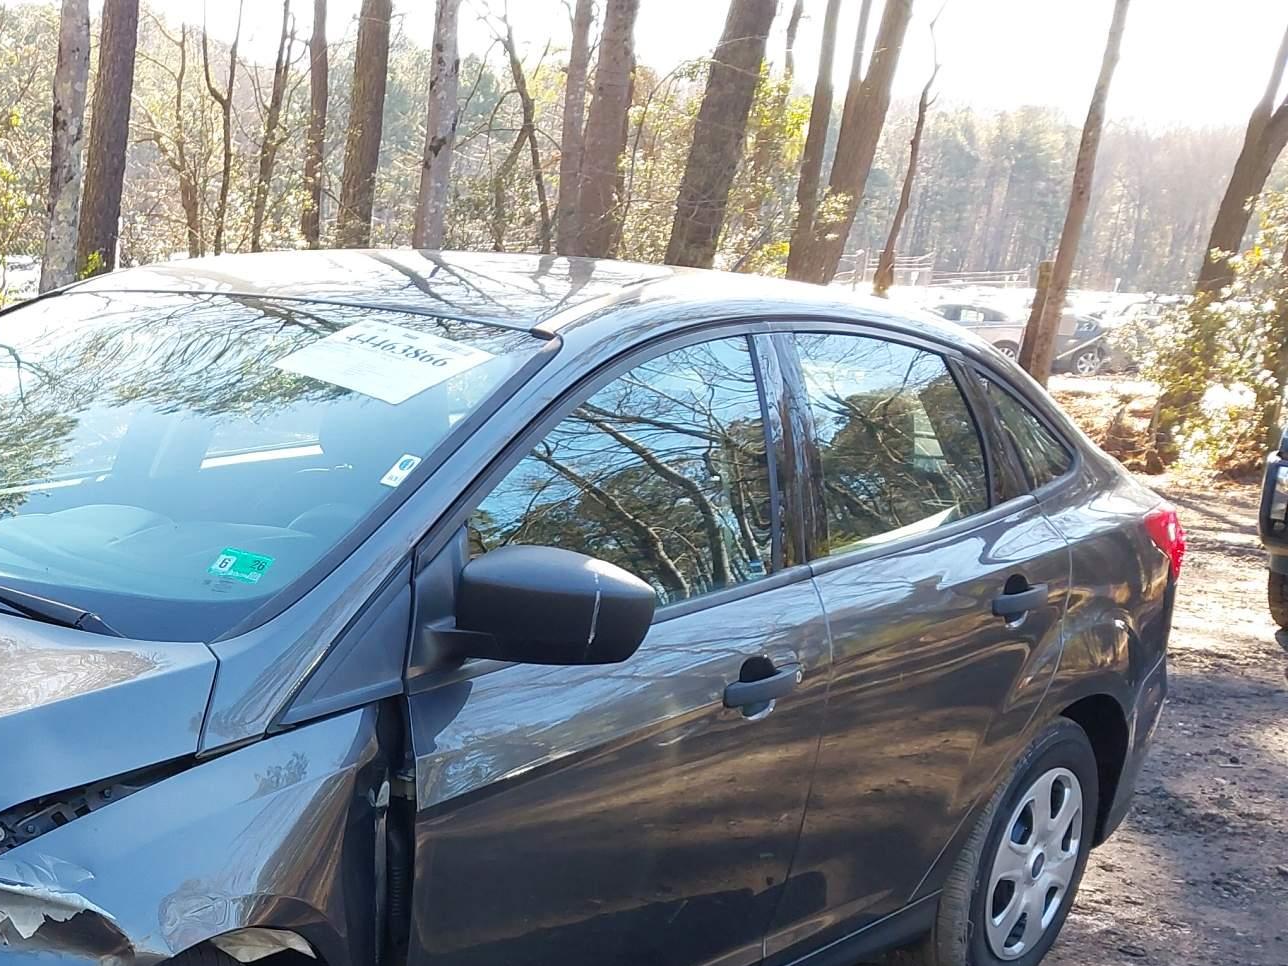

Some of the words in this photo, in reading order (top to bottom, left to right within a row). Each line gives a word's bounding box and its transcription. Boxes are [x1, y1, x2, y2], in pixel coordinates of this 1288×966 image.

[345, 333, 449, 368] 44463866
[218, 558, 231, 569] 6
[250, 560, 268, 571] 26
